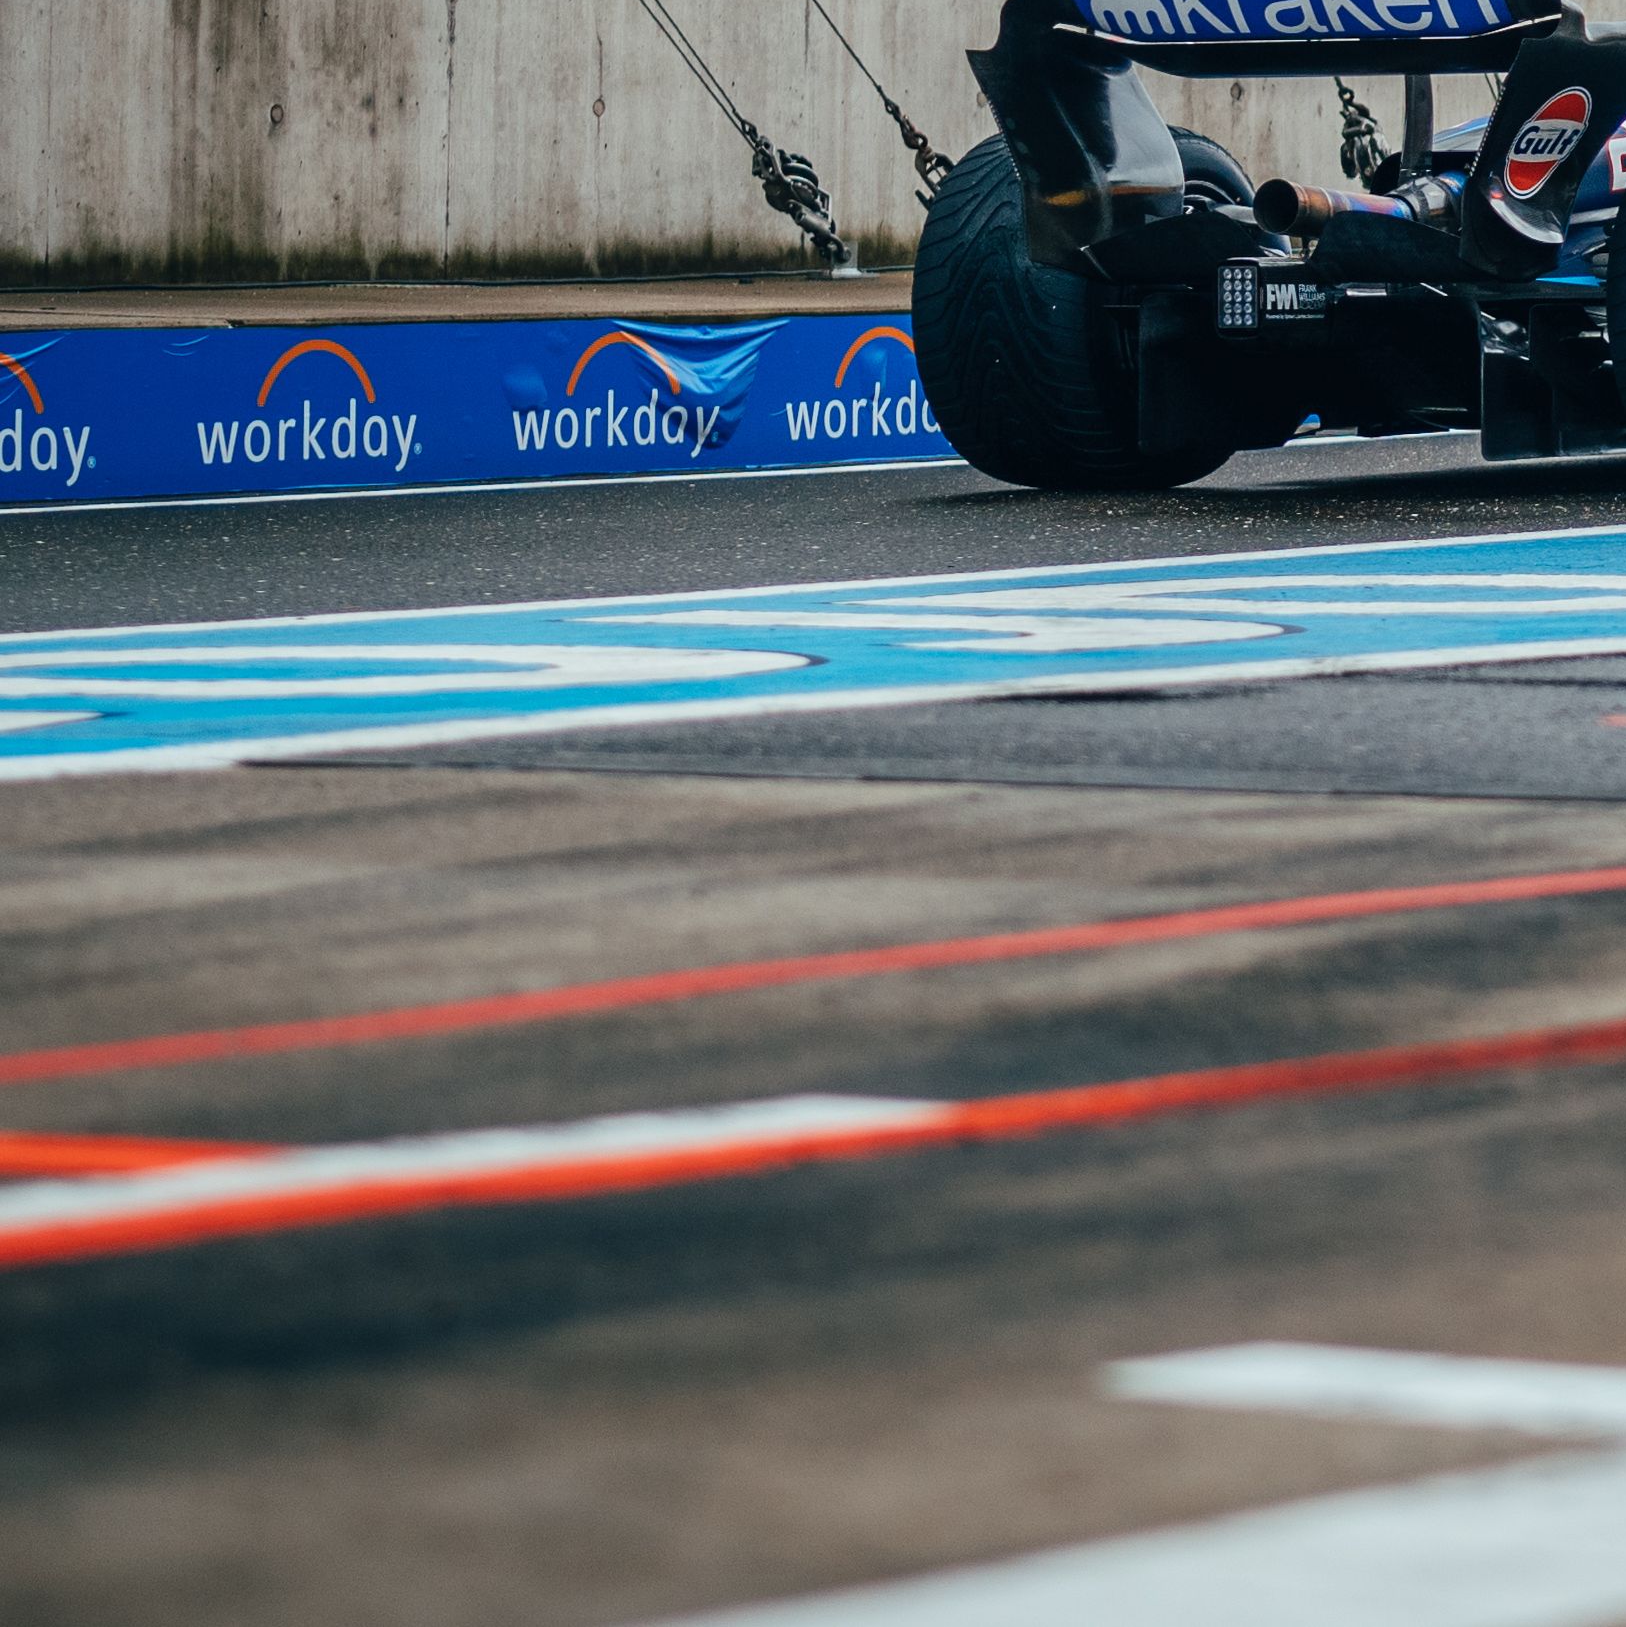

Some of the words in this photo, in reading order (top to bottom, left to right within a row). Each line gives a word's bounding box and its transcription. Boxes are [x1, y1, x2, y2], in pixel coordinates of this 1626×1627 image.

[1513, 125, 1581, 156] Gulf
[197, 397, 417, 472] workday
[512, 388, 720, 459] workday
